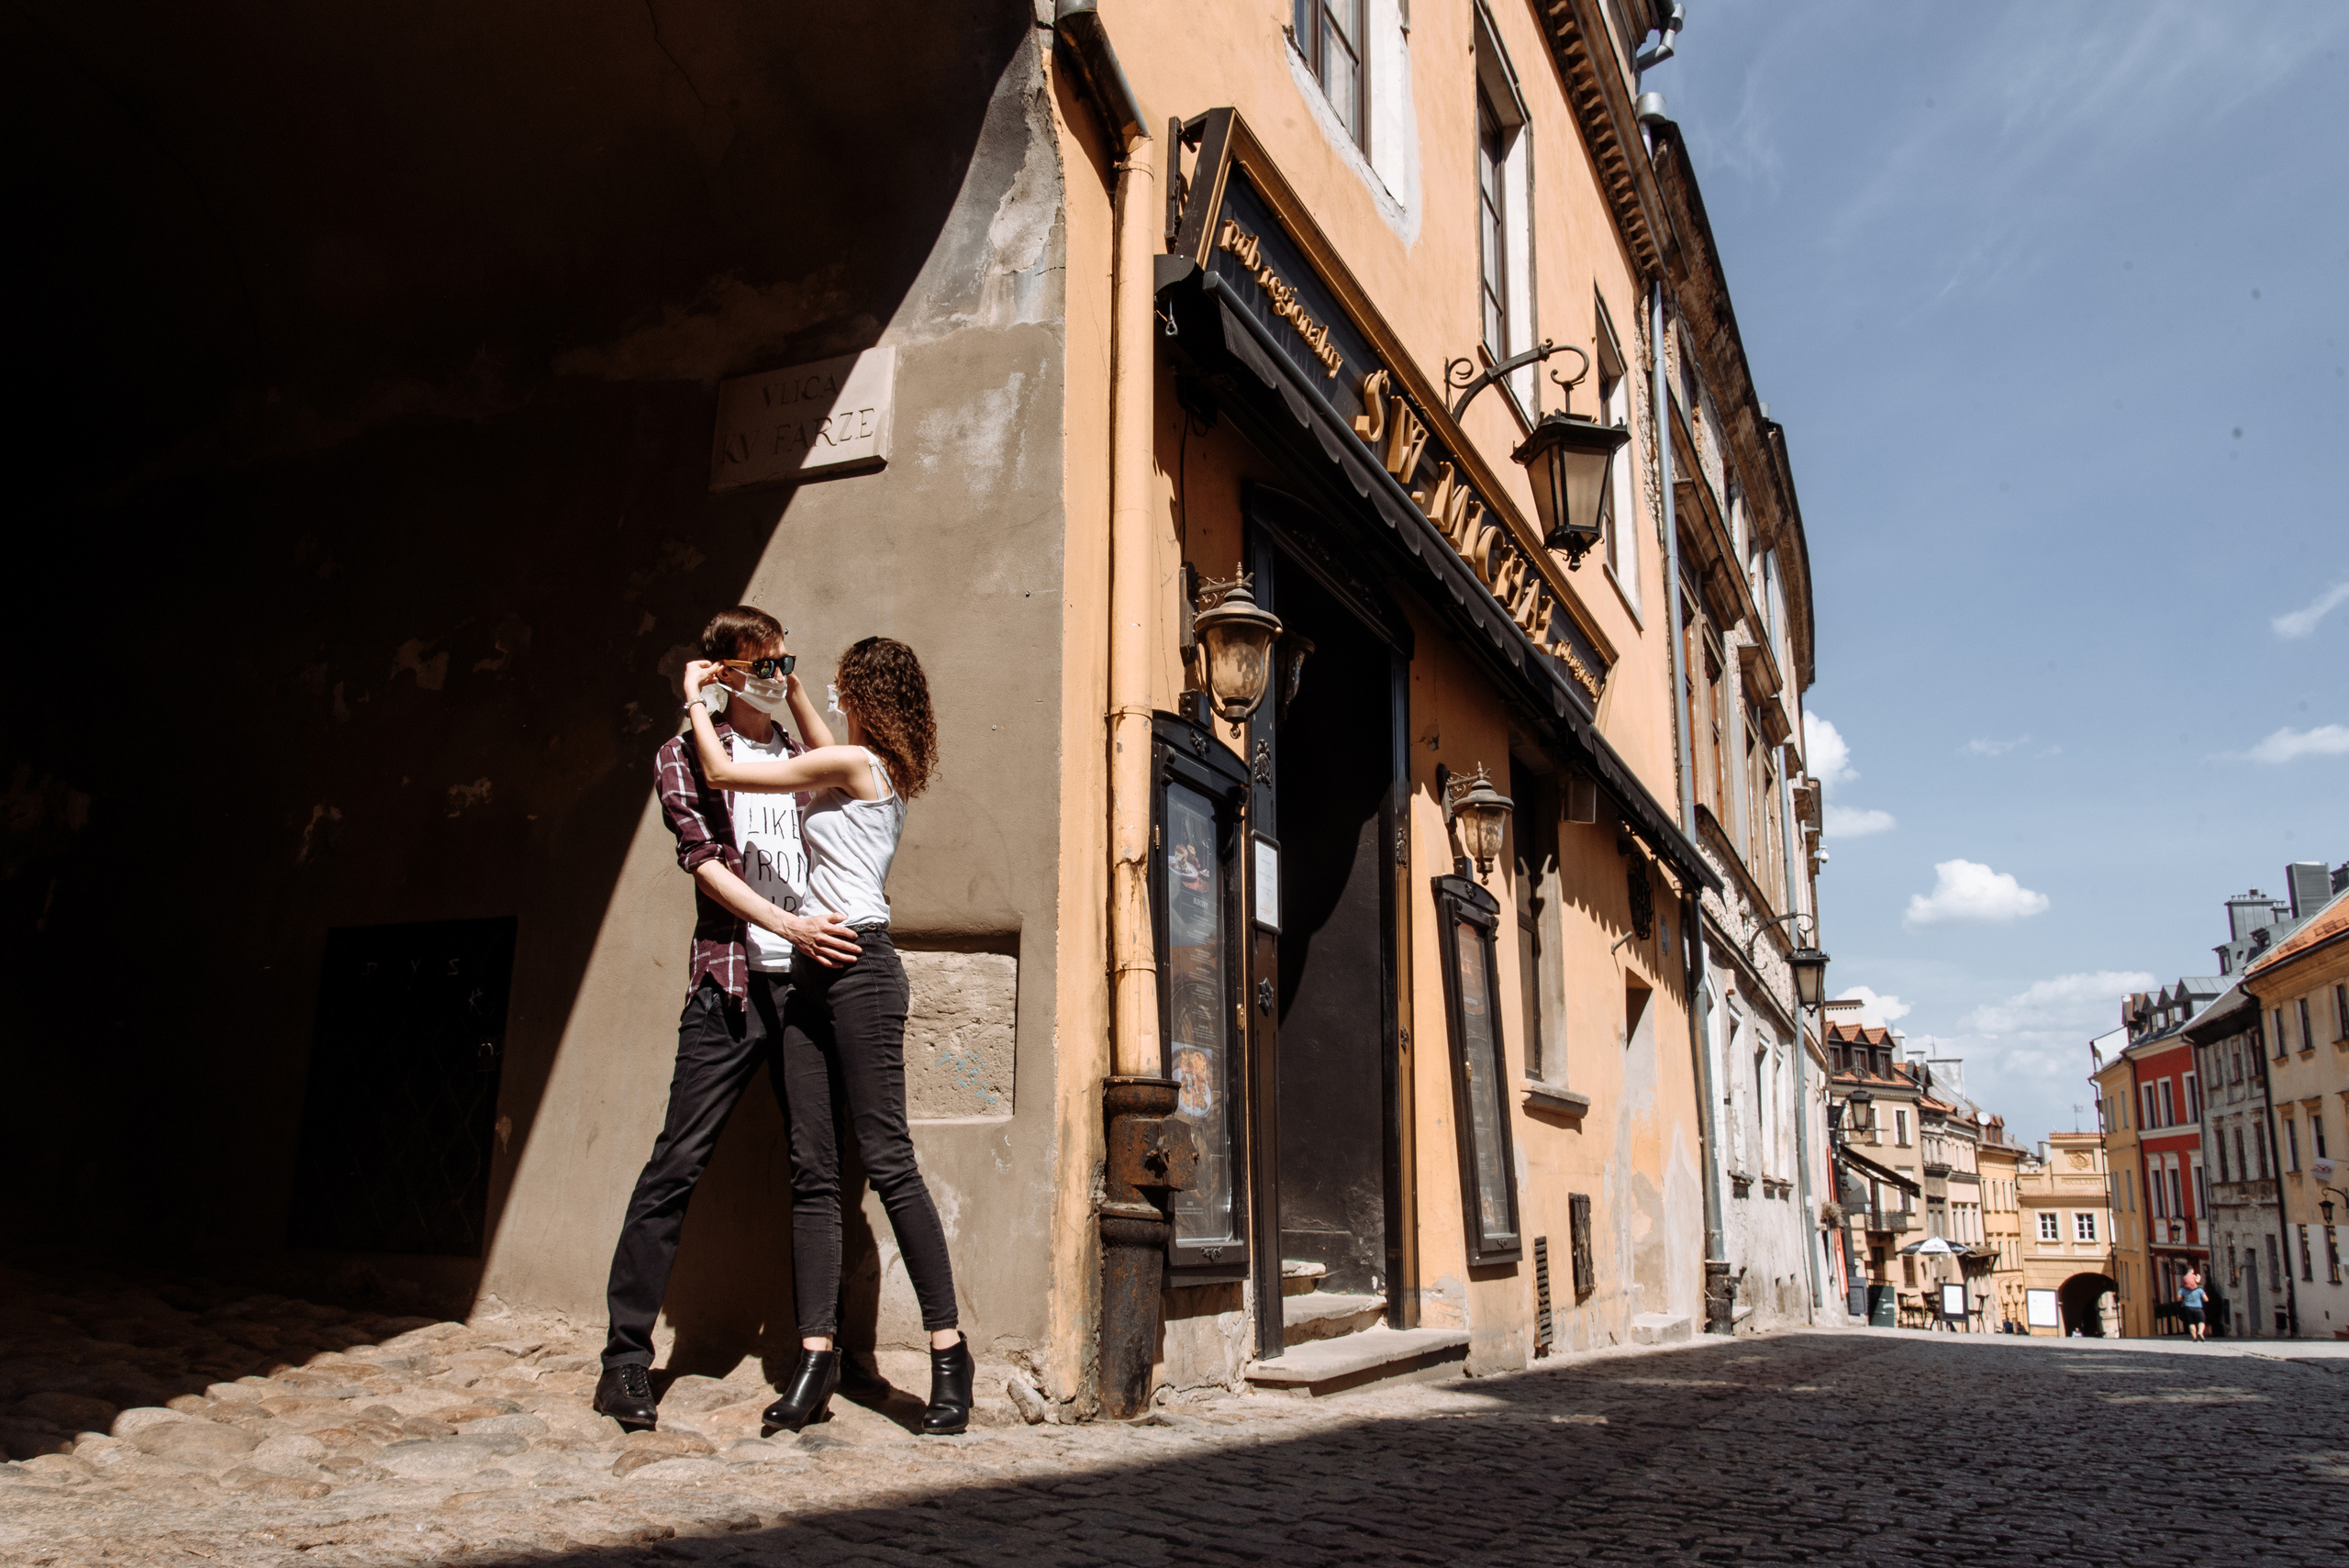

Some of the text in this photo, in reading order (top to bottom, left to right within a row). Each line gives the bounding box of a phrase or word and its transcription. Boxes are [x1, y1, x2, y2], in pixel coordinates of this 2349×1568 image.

[1219, 219, 1343, 379] pub regionalny
[773, 407, 875, 455] FARZE
[747, 806, 800, 840] LIKE
